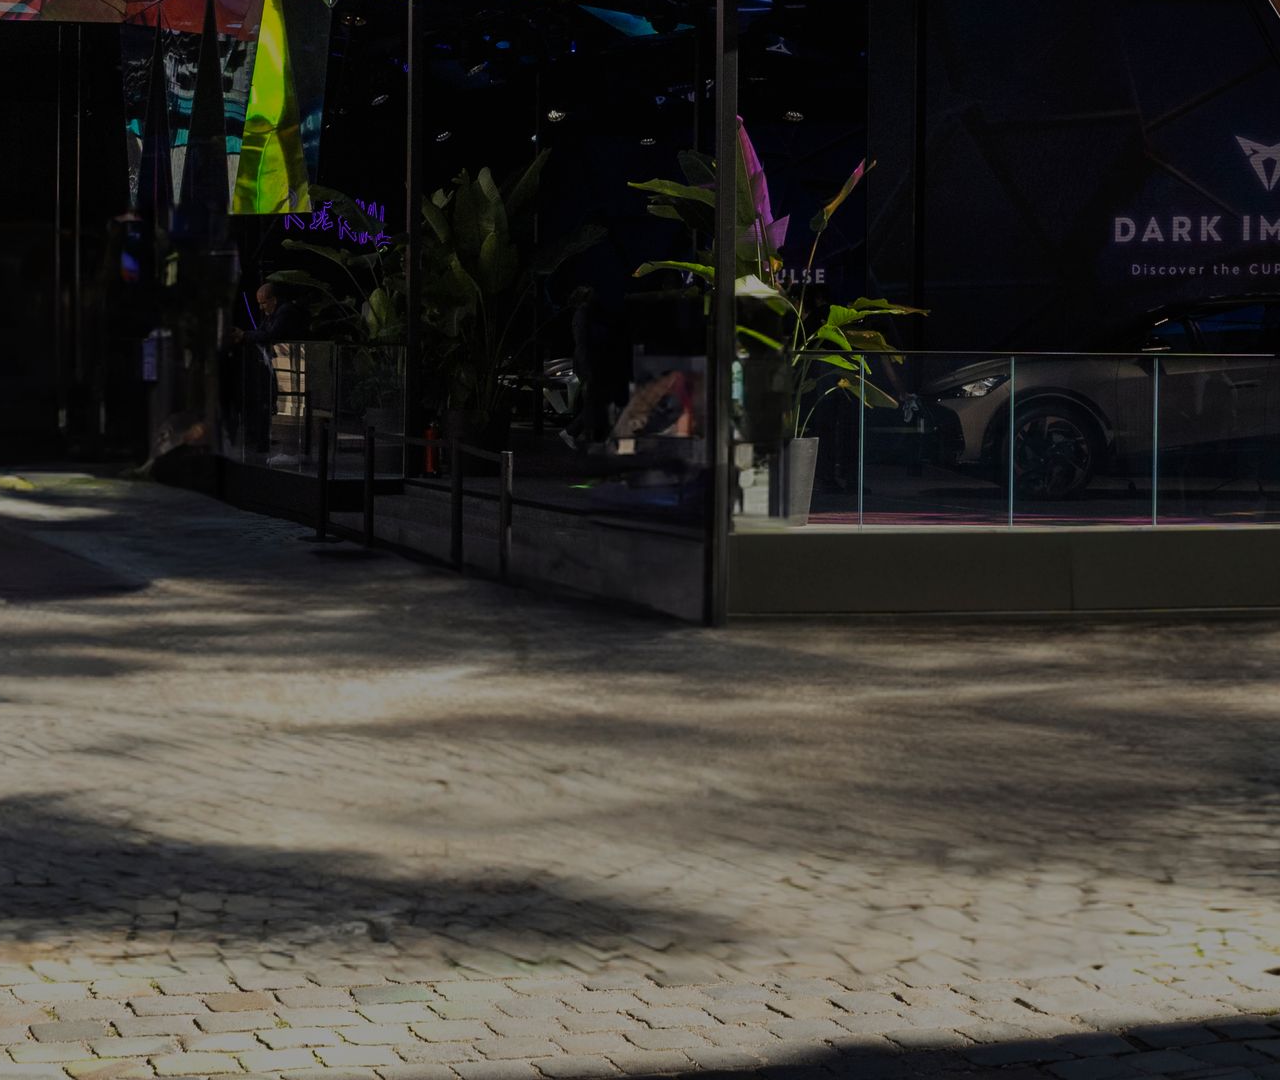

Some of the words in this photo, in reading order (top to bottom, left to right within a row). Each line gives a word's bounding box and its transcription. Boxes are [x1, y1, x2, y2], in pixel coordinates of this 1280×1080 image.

[1114, 217, 1223, 242] DARK
[1131, 263, 1205, 276] Discover
[1213, 263, 1240, 276] the
